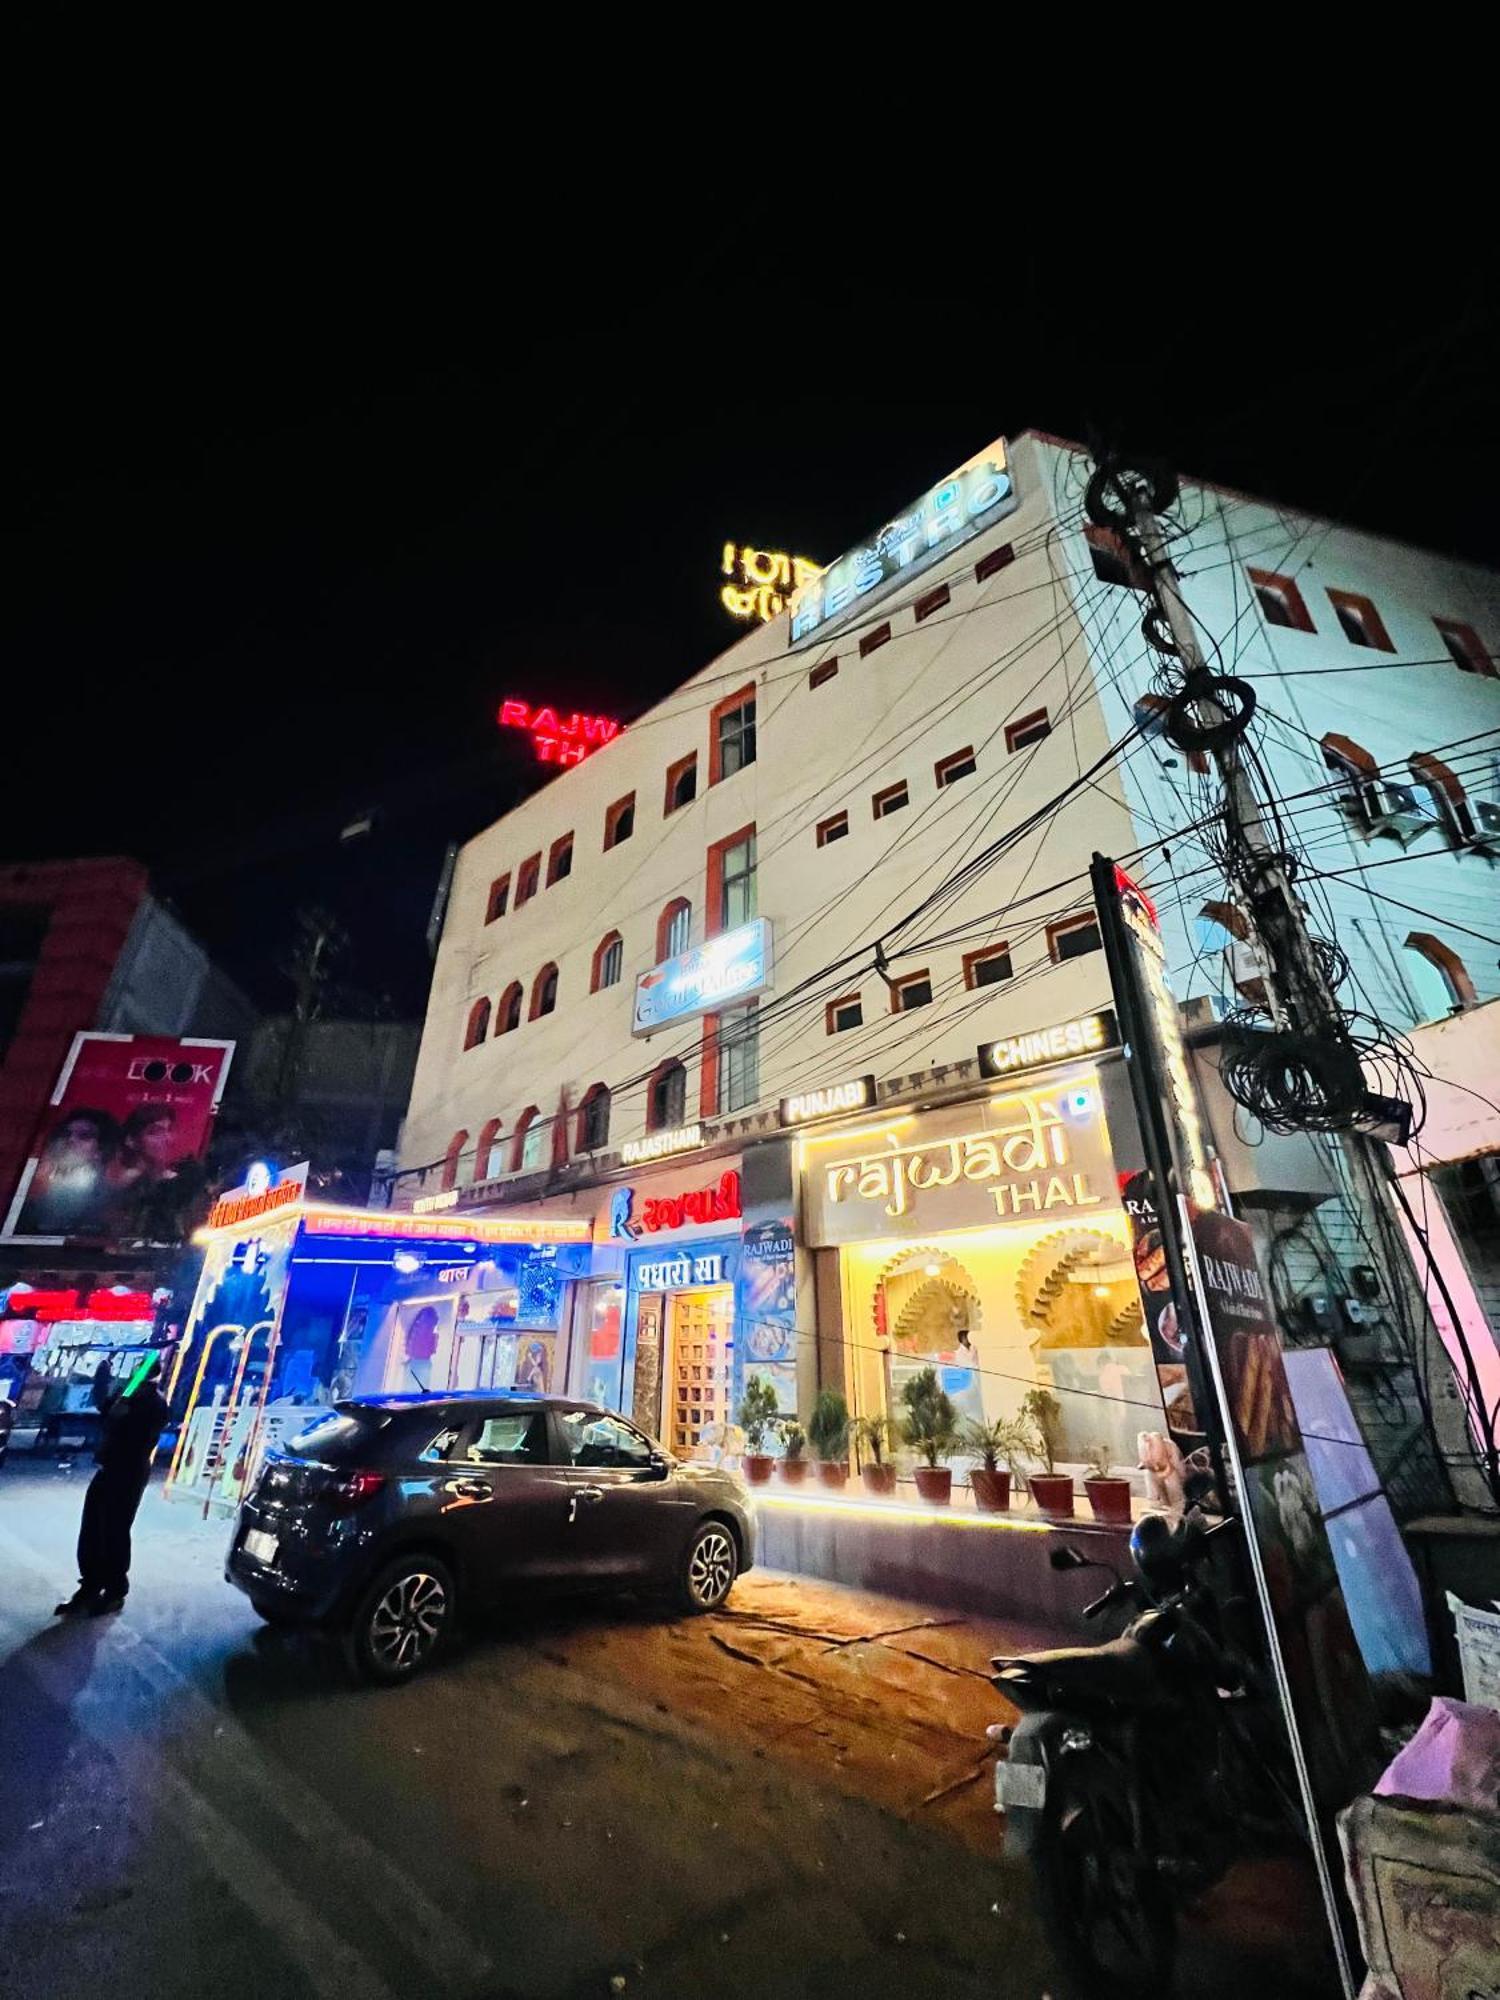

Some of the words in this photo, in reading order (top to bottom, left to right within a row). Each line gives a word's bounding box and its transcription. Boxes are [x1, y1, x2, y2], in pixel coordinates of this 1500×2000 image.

[792, 473, 1011, 642] RESTRO
[500, 700, 624, 742] RAJW
[535, 735, 585, 765] TH
[992, 1015, 1103, 1069] CHINESE
[787, 1080, 867, 1124] PUNJABI
[622, 1124, 705, 1165] RAJASTHANI
[988, 1173, 1101, 1216] THAL
[1126, 1198, 1155, 1216] RA
[743, 1238, 793, 1257] RAJWADI
[438, 1266, 471, 1284] थाल
[638, 1251, 694, 1289] पधारो
[1203, 1254, 1265, 1300] RAJWADI
